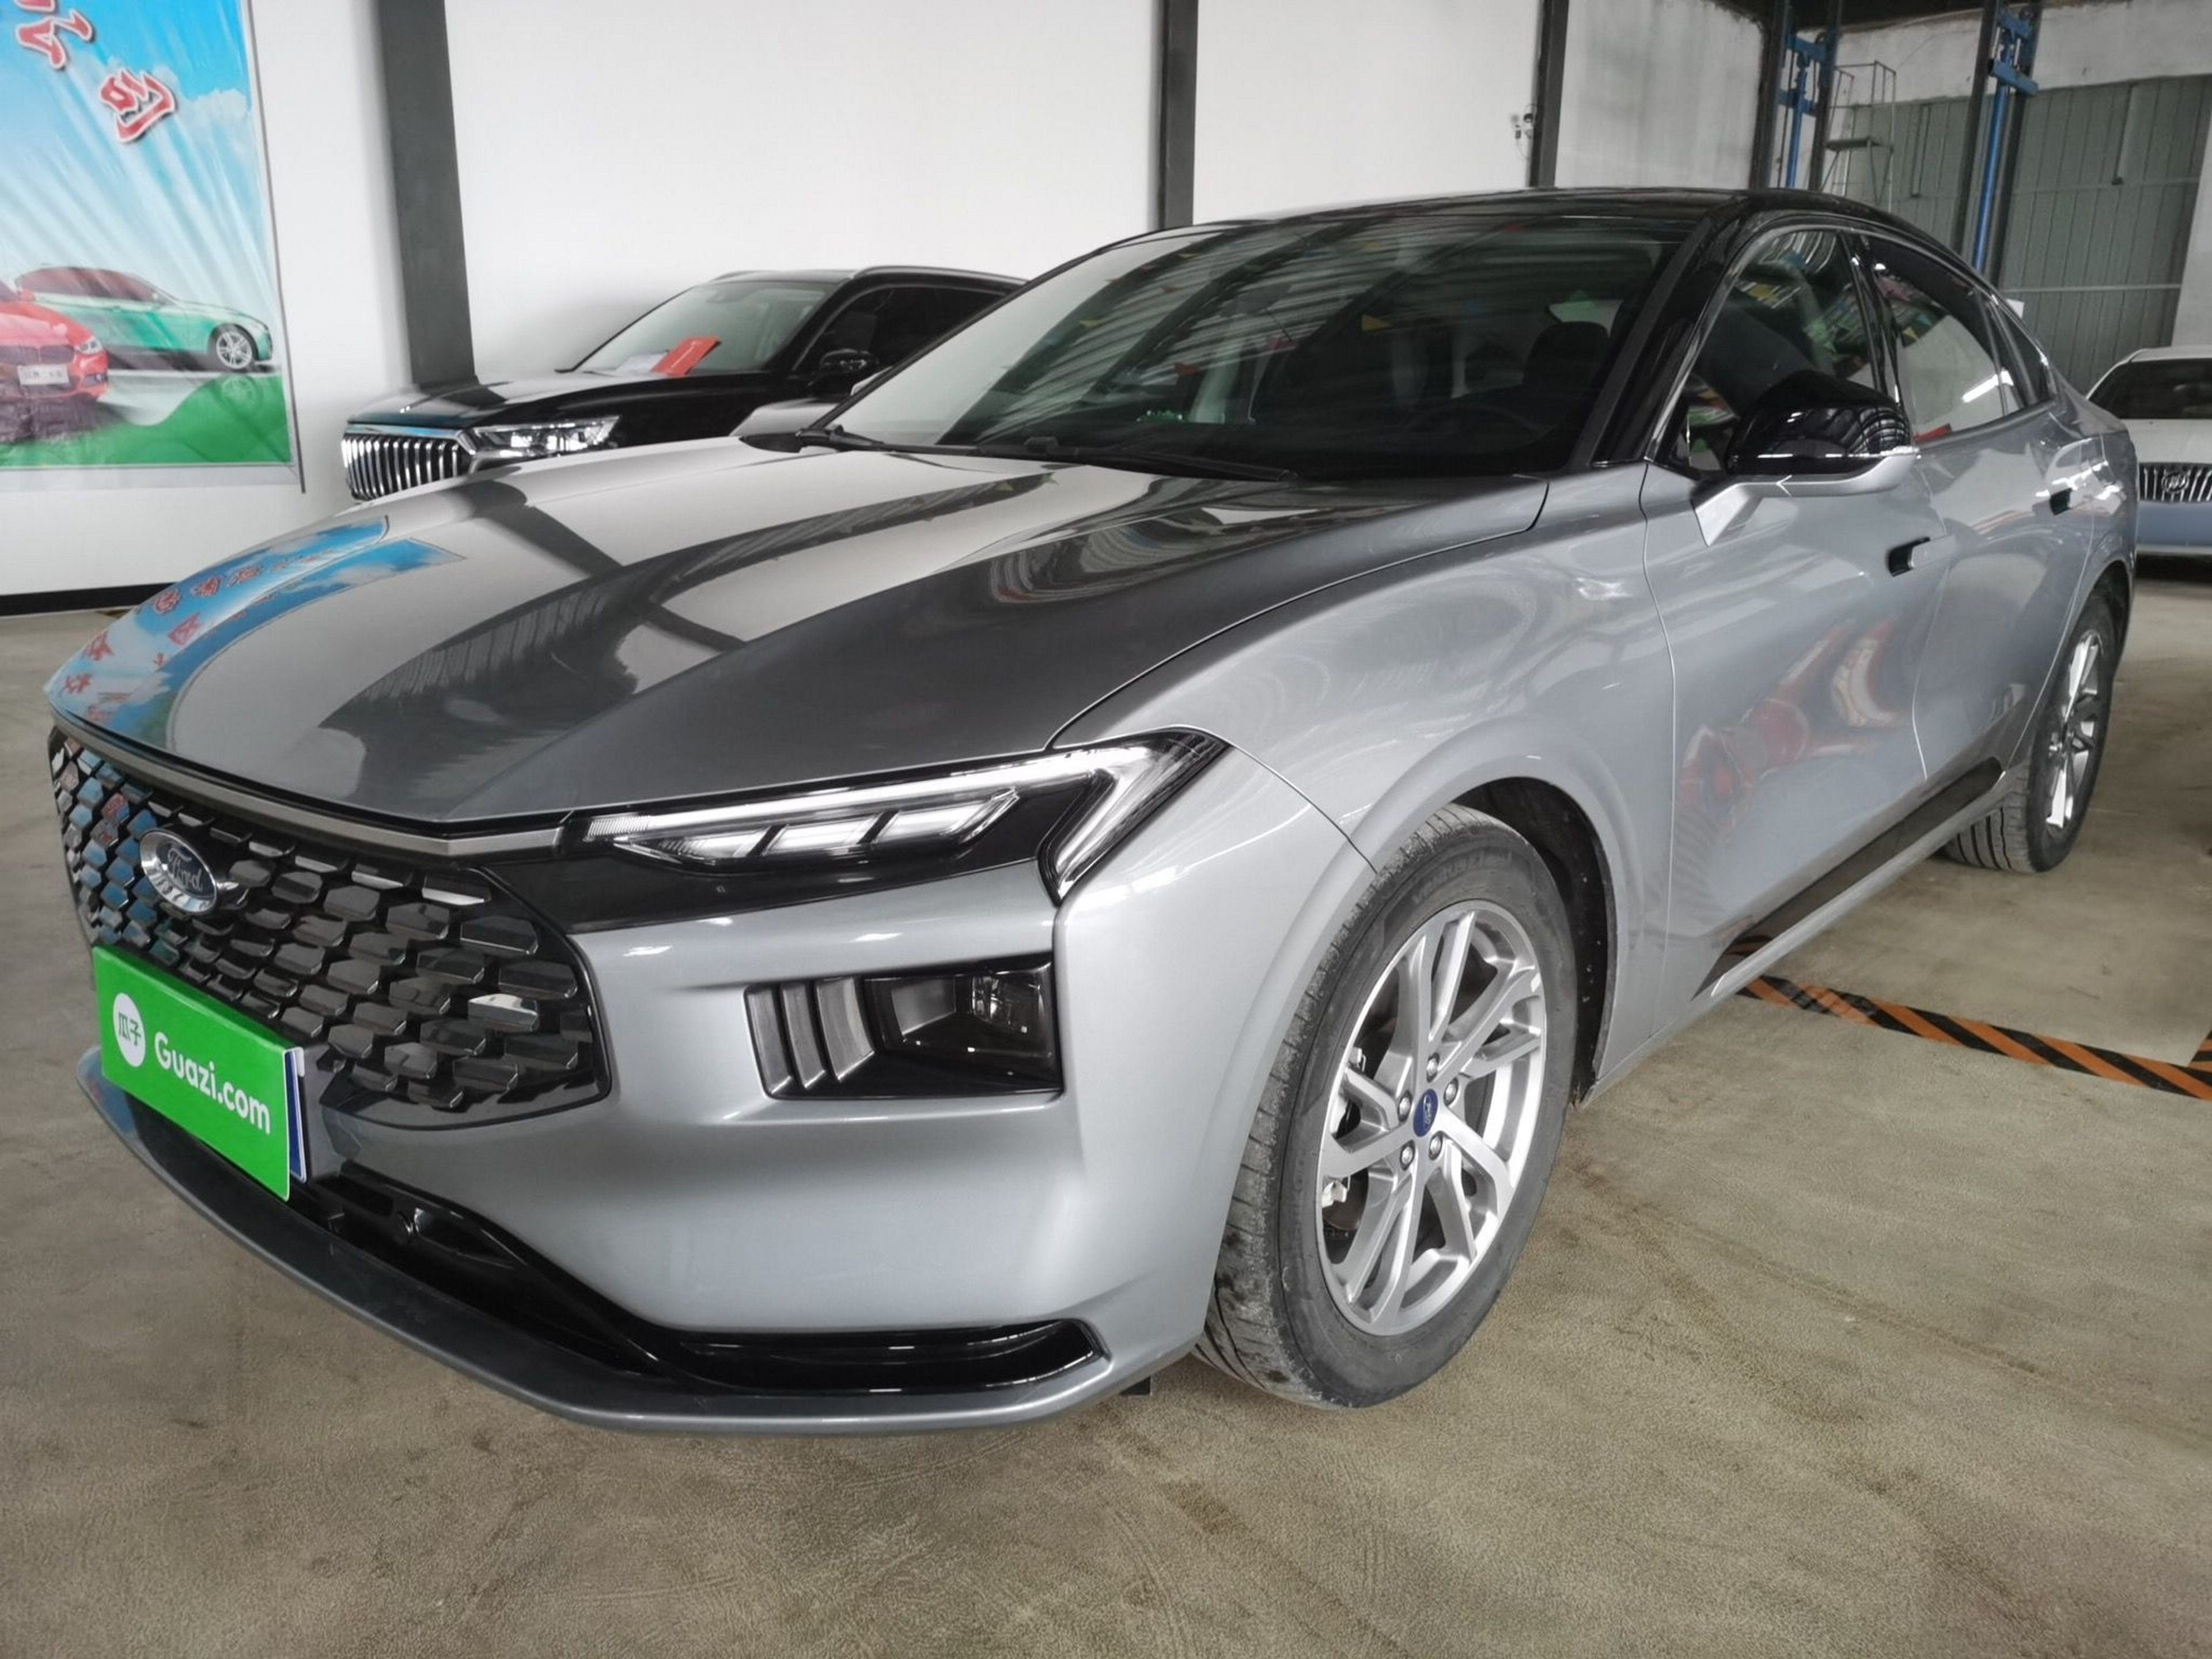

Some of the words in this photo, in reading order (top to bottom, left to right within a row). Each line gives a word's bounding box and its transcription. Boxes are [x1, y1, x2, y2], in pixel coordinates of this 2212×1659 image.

[167, 847, 203, 892] Ford
[119, 1012, 142, 1047] 瓜子
[155, 1031, 270, 1135] Guazi.com
